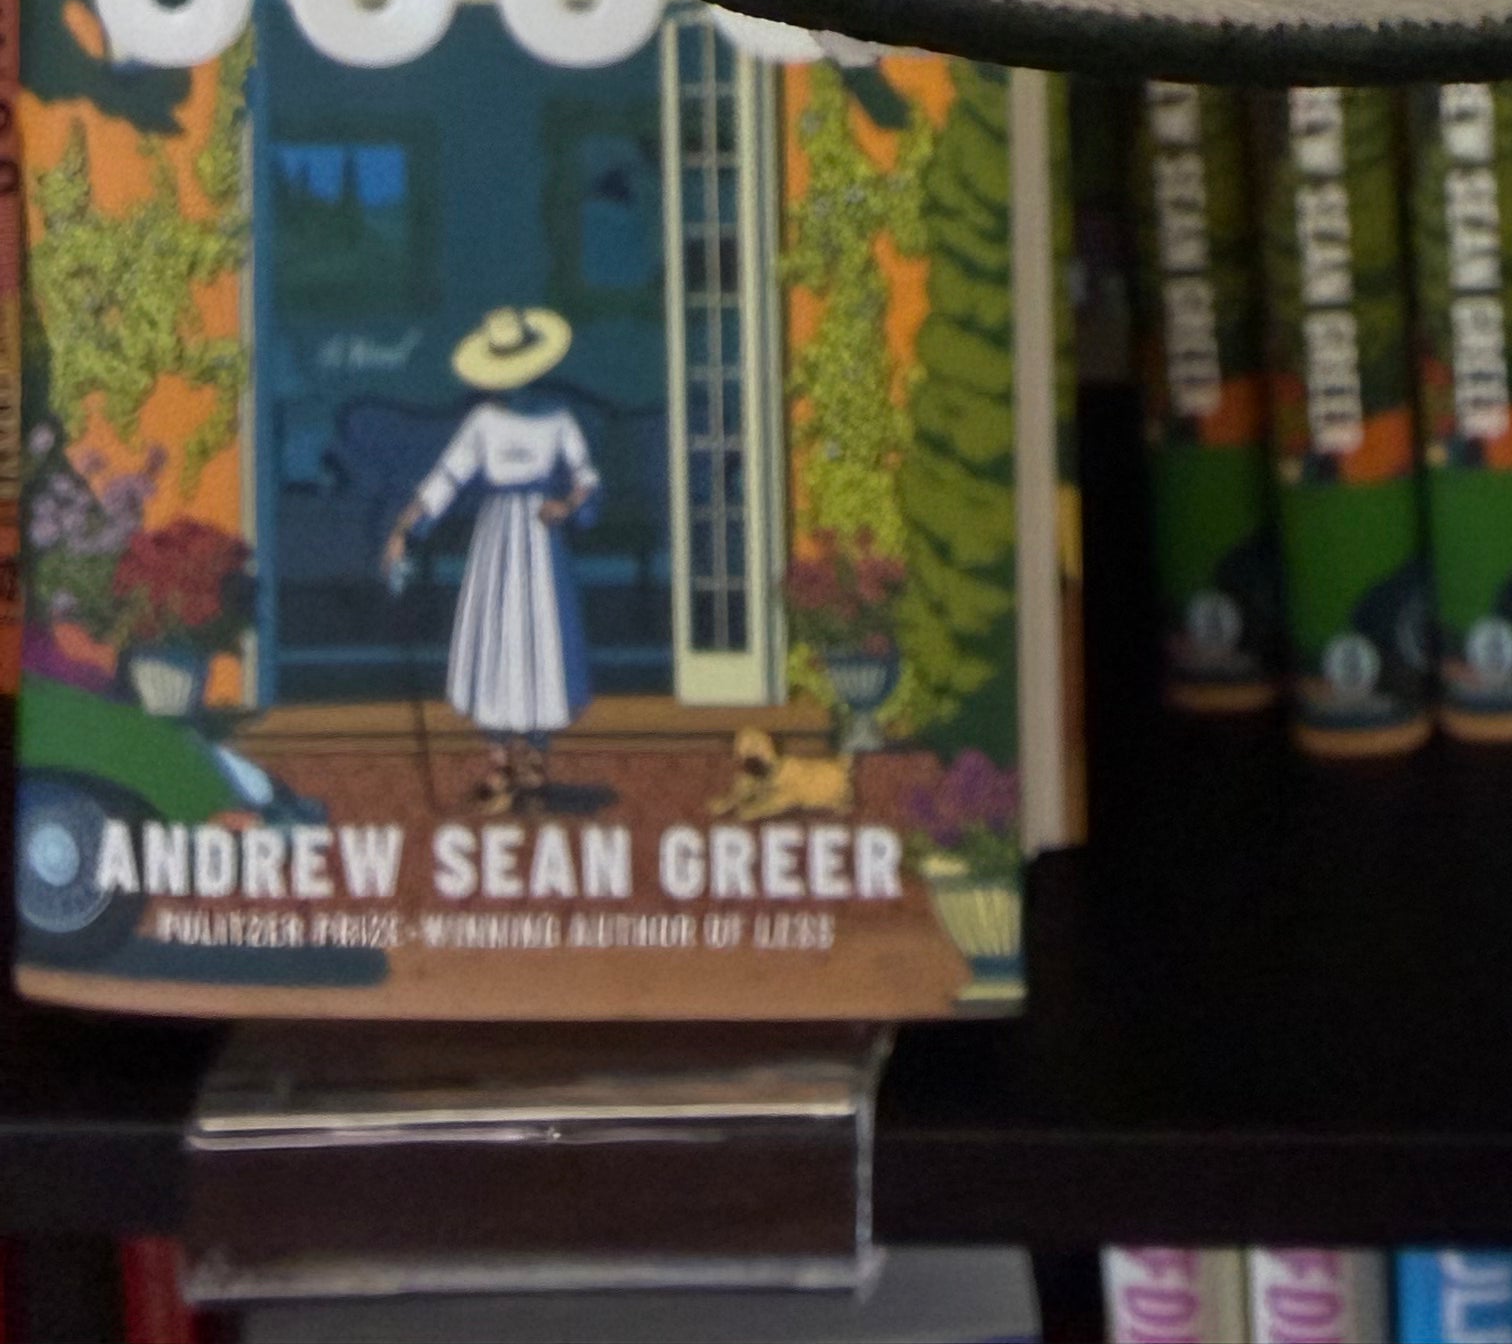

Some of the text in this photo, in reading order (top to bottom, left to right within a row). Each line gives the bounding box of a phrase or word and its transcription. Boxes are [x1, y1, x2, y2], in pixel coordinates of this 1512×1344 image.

[94, 822, 904, 900] ANDREW SEAN GREER
[567, 910, 698, 950] AUTHOR
